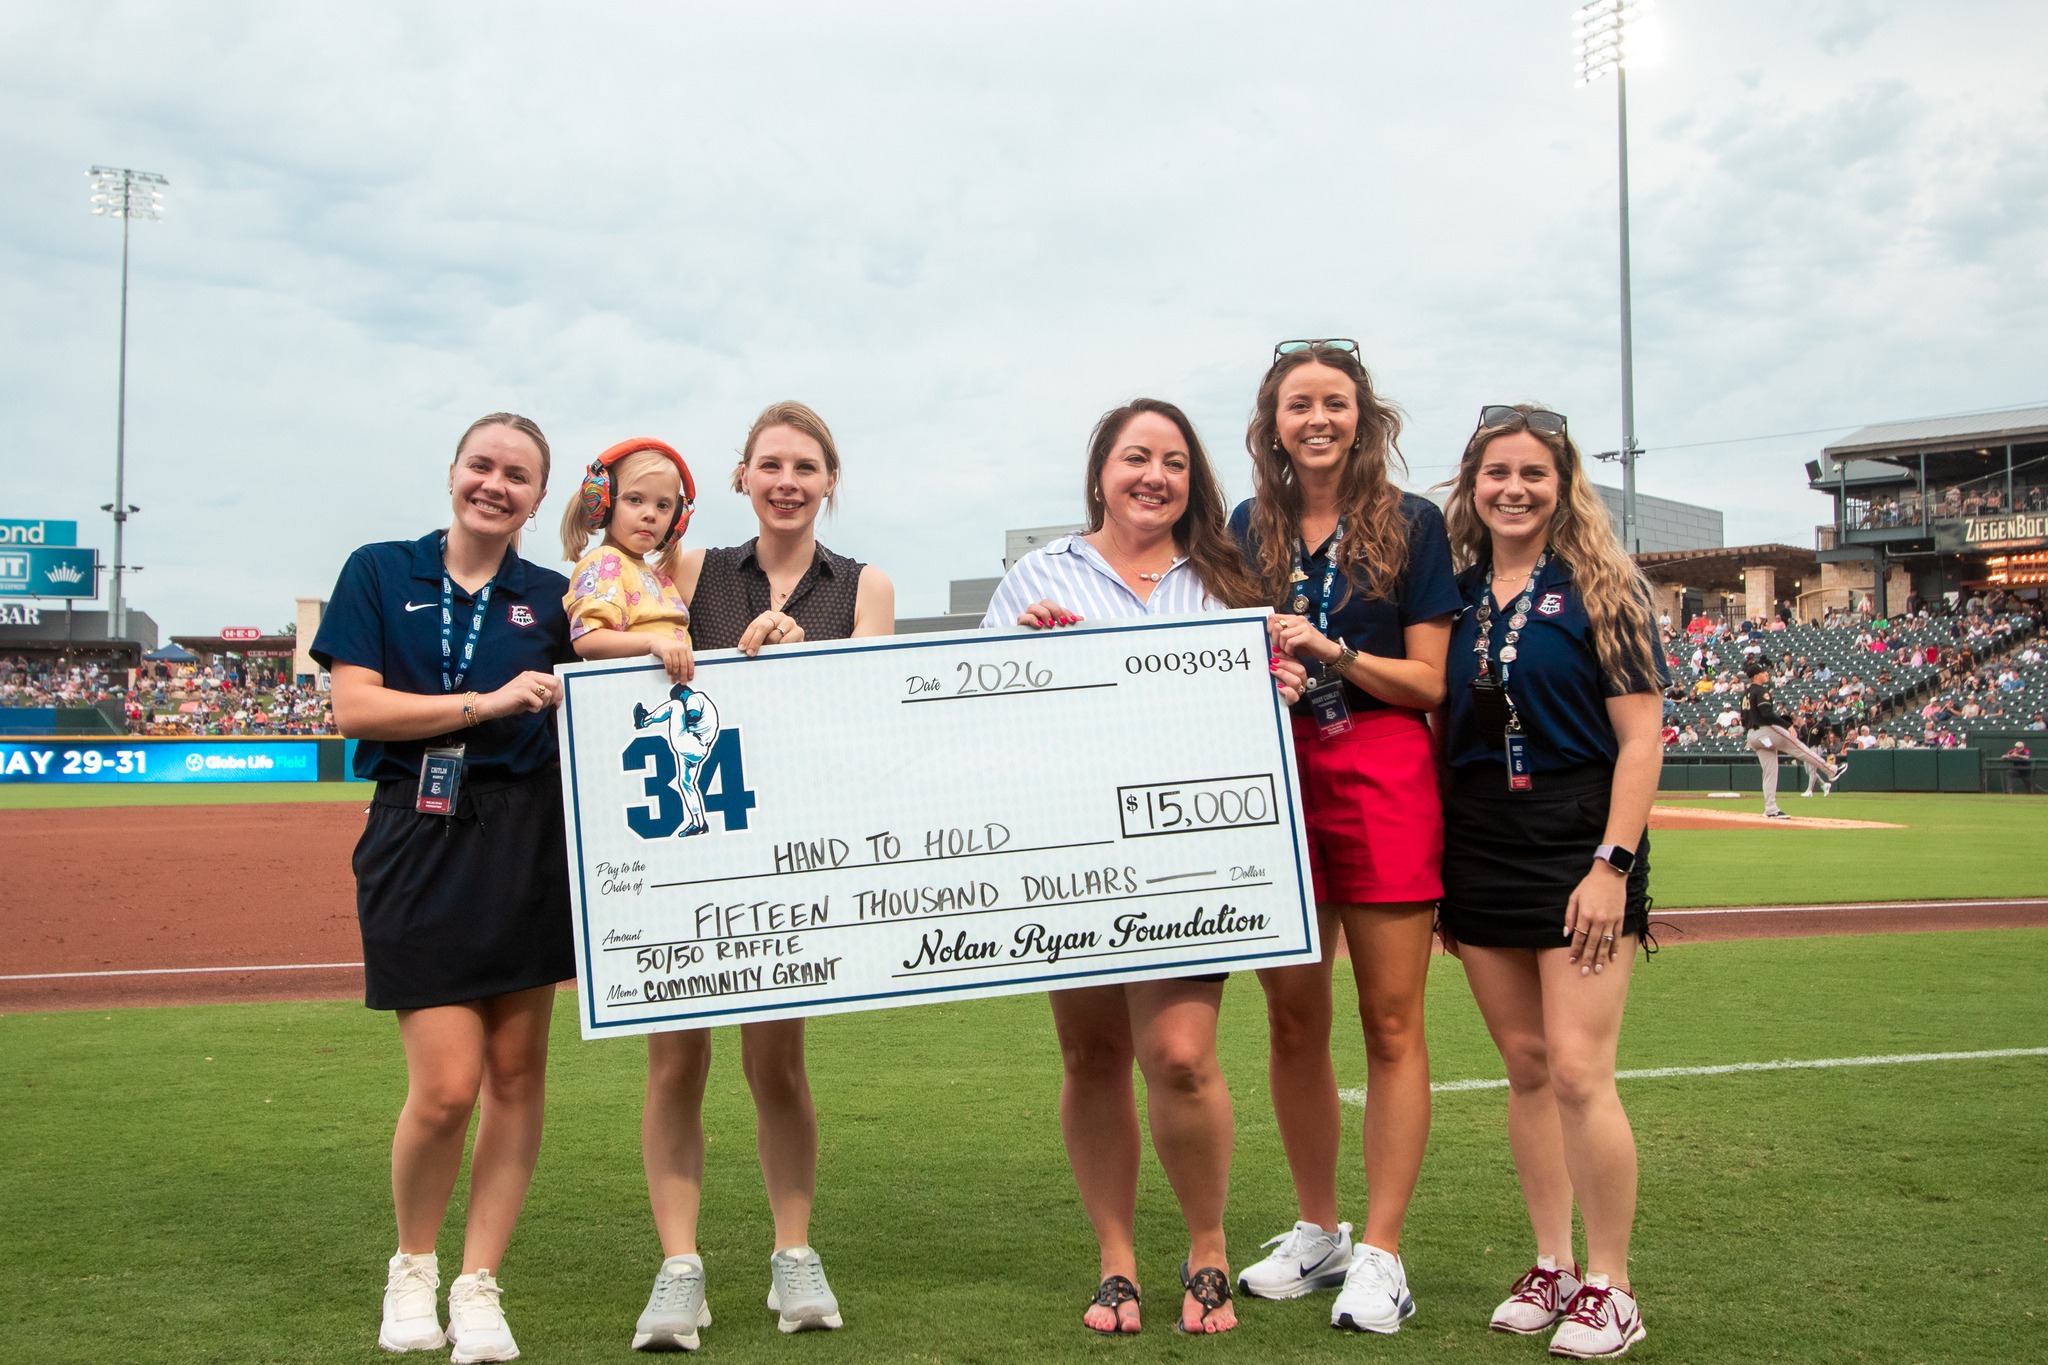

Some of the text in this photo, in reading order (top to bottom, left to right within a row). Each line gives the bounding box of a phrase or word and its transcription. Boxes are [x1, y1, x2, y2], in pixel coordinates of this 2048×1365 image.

[1125, 648, 1251, 675] 0003034
[906, 675, 942, 695] Date
[956, 660, 1053, 695] 2026
[0, 750, 146, 775] AY 29-31
[205, 754, 306, 769] Globe Life Field
[621, 728, 756, 840] 34
[1126, 786, 1267, 829] $15,000
[774, 822, 1011, 873] HAND TO HOLD
[595, 860, 646, 880] Pay to the
[1230, 865, 1266, 882] Dollars
[601, 878, 643, 895] Order of
[694, 866, 1139, 938] FIFTEEN THOUSAND DOLLARS
[602, 928, 643, 945] Amount
[903, 904, 1271, 969] Nolan Ryan Foundation
[636, 935, 804, 974] 50/50 RAFFLE
[606, 984, 638, 1001] Memo
[643, 956, 843, 1002] COMMUNITY GRANT
